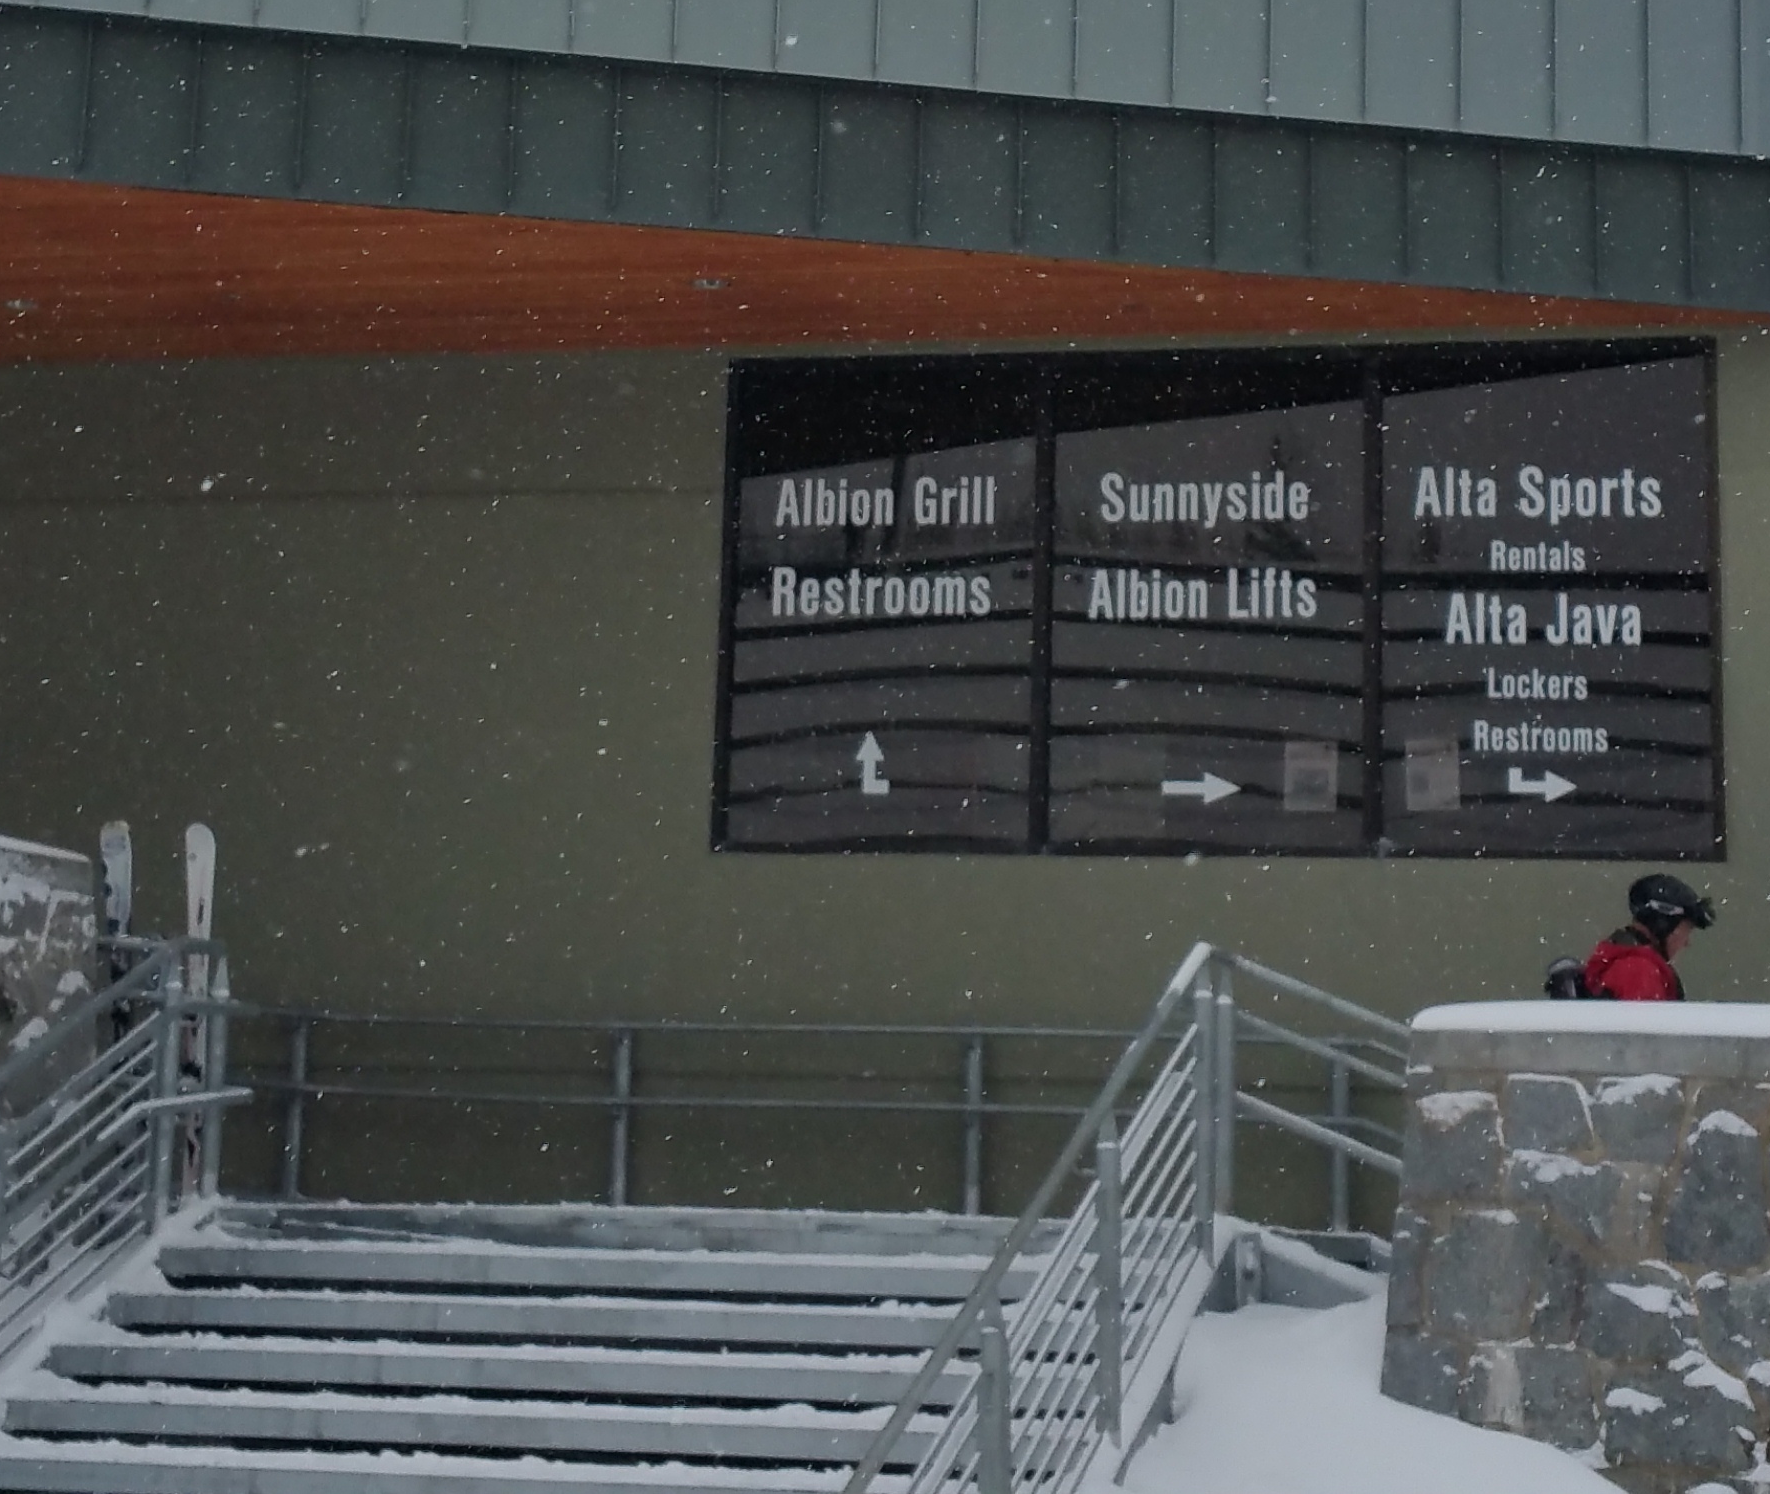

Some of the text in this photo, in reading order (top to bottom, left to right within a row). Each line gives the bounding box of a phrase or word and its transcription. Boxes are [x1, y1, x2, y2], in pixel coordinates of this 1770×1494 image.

[776, 476, 997, 527] Albion Grill
[1100, 471, 1309, 528] Sunnyside
[1415, 464, 1662, 526] Alta Sports
[1490, 539, 1585, 572] Rentals
[772, 566, 992, 617] Restrooms
[1089, 566, 1318, 620] Albion Lifts
[1446, 592, 1642, 646] Alta Java
[1487, 667, 1589, 700] Lockers
[1473, 719, 1609, 753] Restrooms
